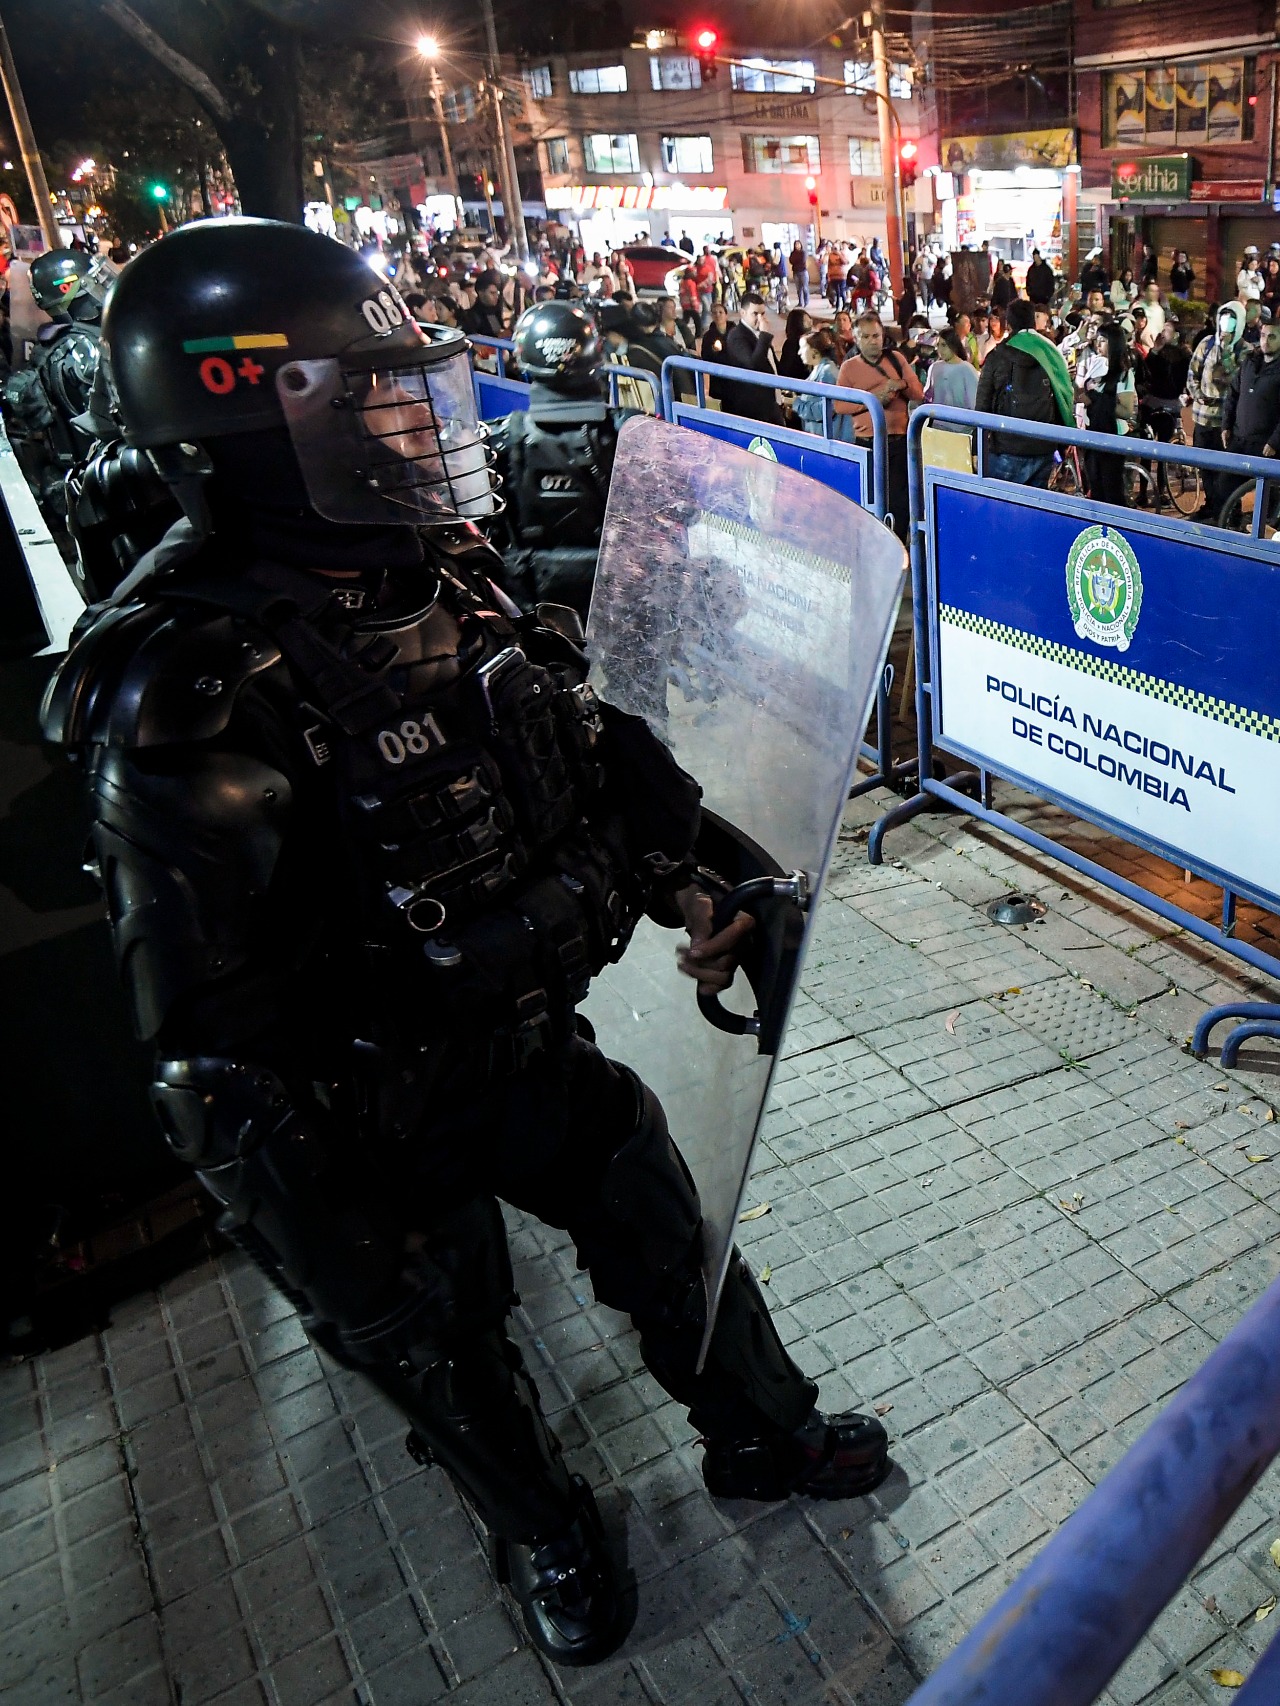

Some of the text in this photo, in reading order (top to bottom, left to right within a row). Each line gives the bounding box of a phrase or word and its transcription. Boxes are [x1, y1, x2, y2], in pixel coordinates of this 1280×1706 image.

[1101, 540, 1110, 549] DE
[1083, 623, 1096, 638] DIOS
[1101, 634, 1121, 643] PATRIA
[1101, 611, 1129, 632] NACIONAL
[377, 712, 447, 764] 081
[986, 674, 1236, 794] POLICÍA NACIONAL
[1012, 716, 1192, 813] DE COLOMBIA
